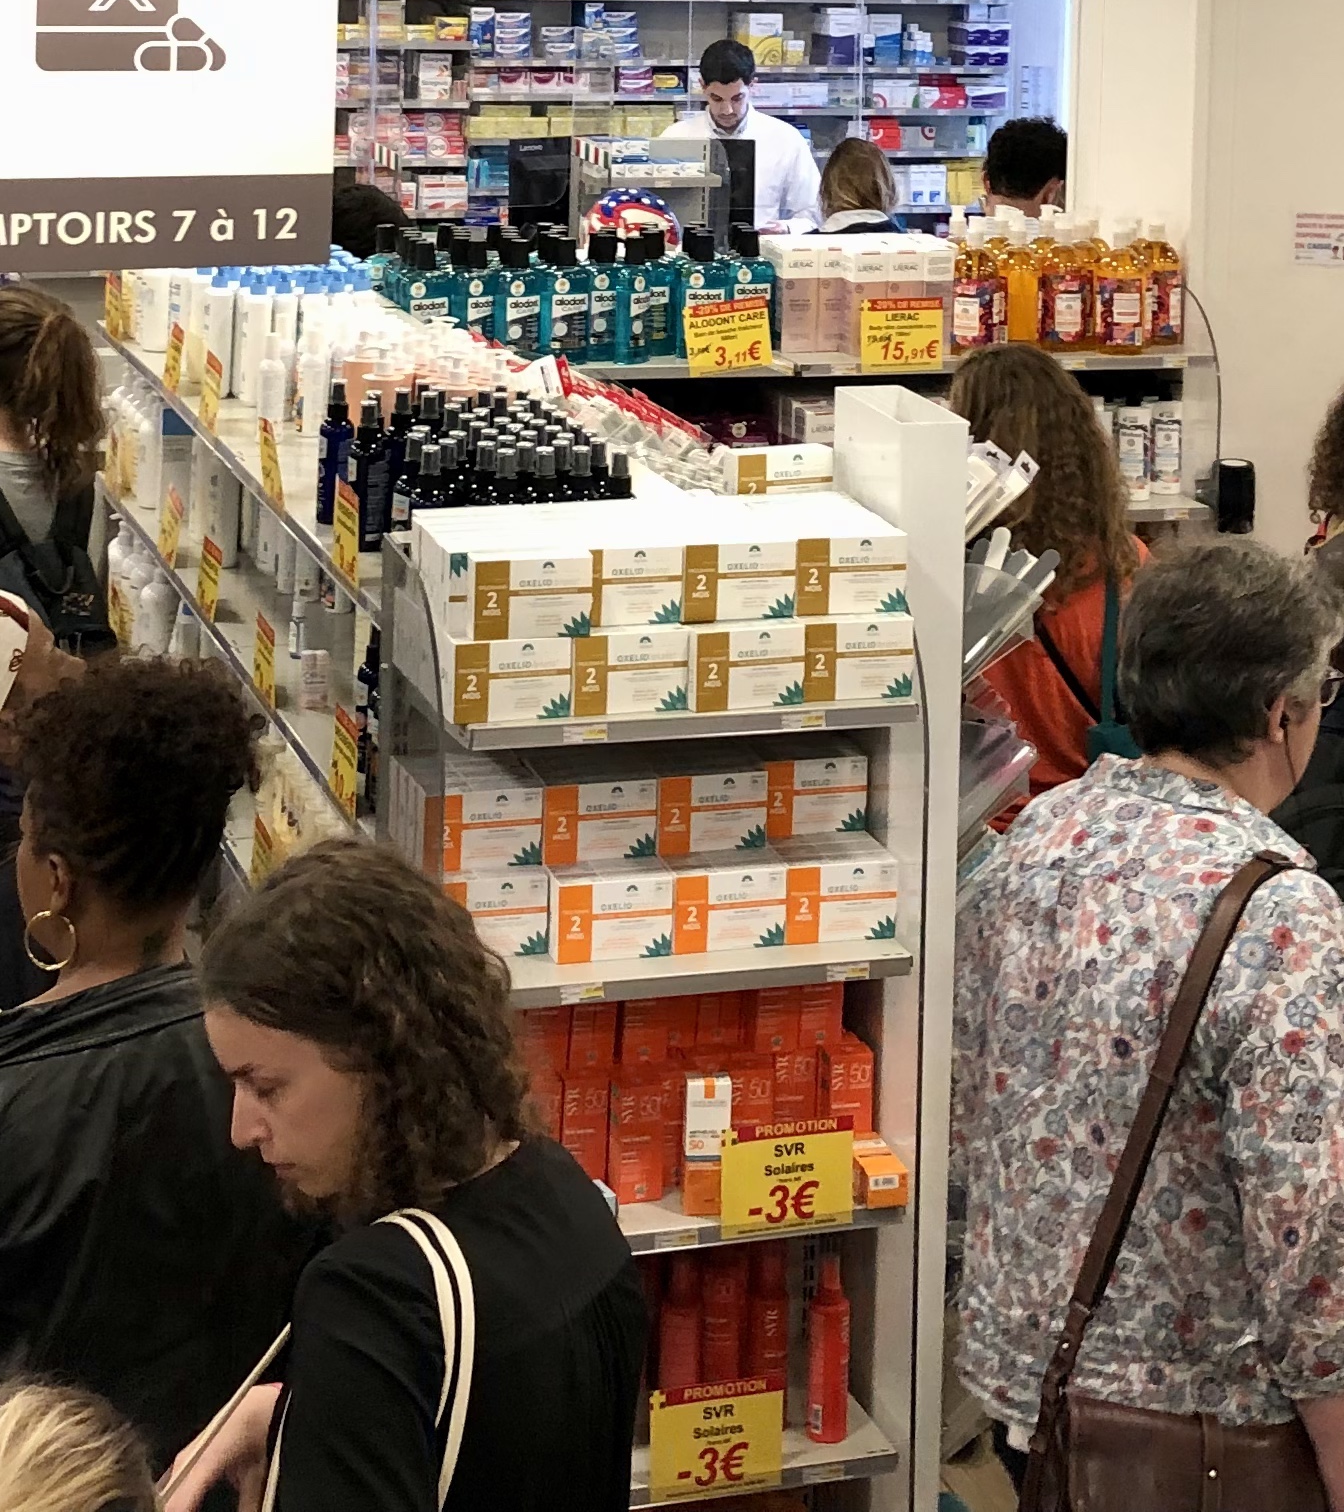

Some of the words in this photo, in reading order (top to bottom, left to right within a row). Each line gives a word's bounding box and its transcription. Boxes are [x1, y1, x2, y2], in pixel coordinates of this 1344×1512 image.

[172, 210, 195, 241] 7
[209, 209, 235, 240] à
[253, 208, 298, 240] 12
[737, 287, 768, 295] alodont
[510, 300, 539, 309] alodont
[555, 298, 587, 307] alodont
[689, 315, 735, 329] ALODONT
[739, 311, 765, 322] CARE
[886, 313, 919, 321] LIERAC
[715, 340, 762, 368] 3,11€
[881, 340, 939, 363] 15,91€
[748, 482, 757, 494] 2
[727, 562, 758, 571] OXELIO
[839, 556, 869, 564] OXELIO
[612, 568, 644, 576] OXELIO
[809, 568, 819, 584] 2
[519, 579, 552, 587] OXELIO
[697, 574, 707, 590] 2
[487, 592, 497, 608] 2
[738, 649, 768, 658] OXELIO
[846, 641, 876, 650] OXELIO
[499, 661, 531, 670] OXELIO
[617, 654, 649, 662] OXELIO
[815, 654, 825, 670] 2
[586, 668, 597, 684] 2
[708, 663, 719, 679] 2
[467, 675, 477, 692] 2
[698, 794, 729, 803] OXELIO
[774, 791, 783, 806] 2
[586, 803, 618, 812] OXELIO
[469, 812, 502, 821] OXELIO
[671, 808, 680, 824] 2
[558, 816, 567, 833] 2
[475, 900, 508, 909] OXELIO
[601, 902, 632, 911] OXELIO
[799, 897, 809, 913] 2
[687, 906, 697, 922] 2
[571, 915, 581, 932] 2
[832, 1062, 845, 1091] SVR
[622, 1096, 634, 1124] SVR
[756, 1119, 838, 1137] PROMOTION
[774, 1143, 805, 1157] SVR
[764, 1162, 814, 1176] Solaires
[748, 1180, 820, 1223] -3€
[684, 1379, 767, 1400] PROMOTION
[703, 1404, 734, 1420] SVR
[694, 1424, 744, 1439] Solaires
[677, 1442, 749, 1486] -3€
